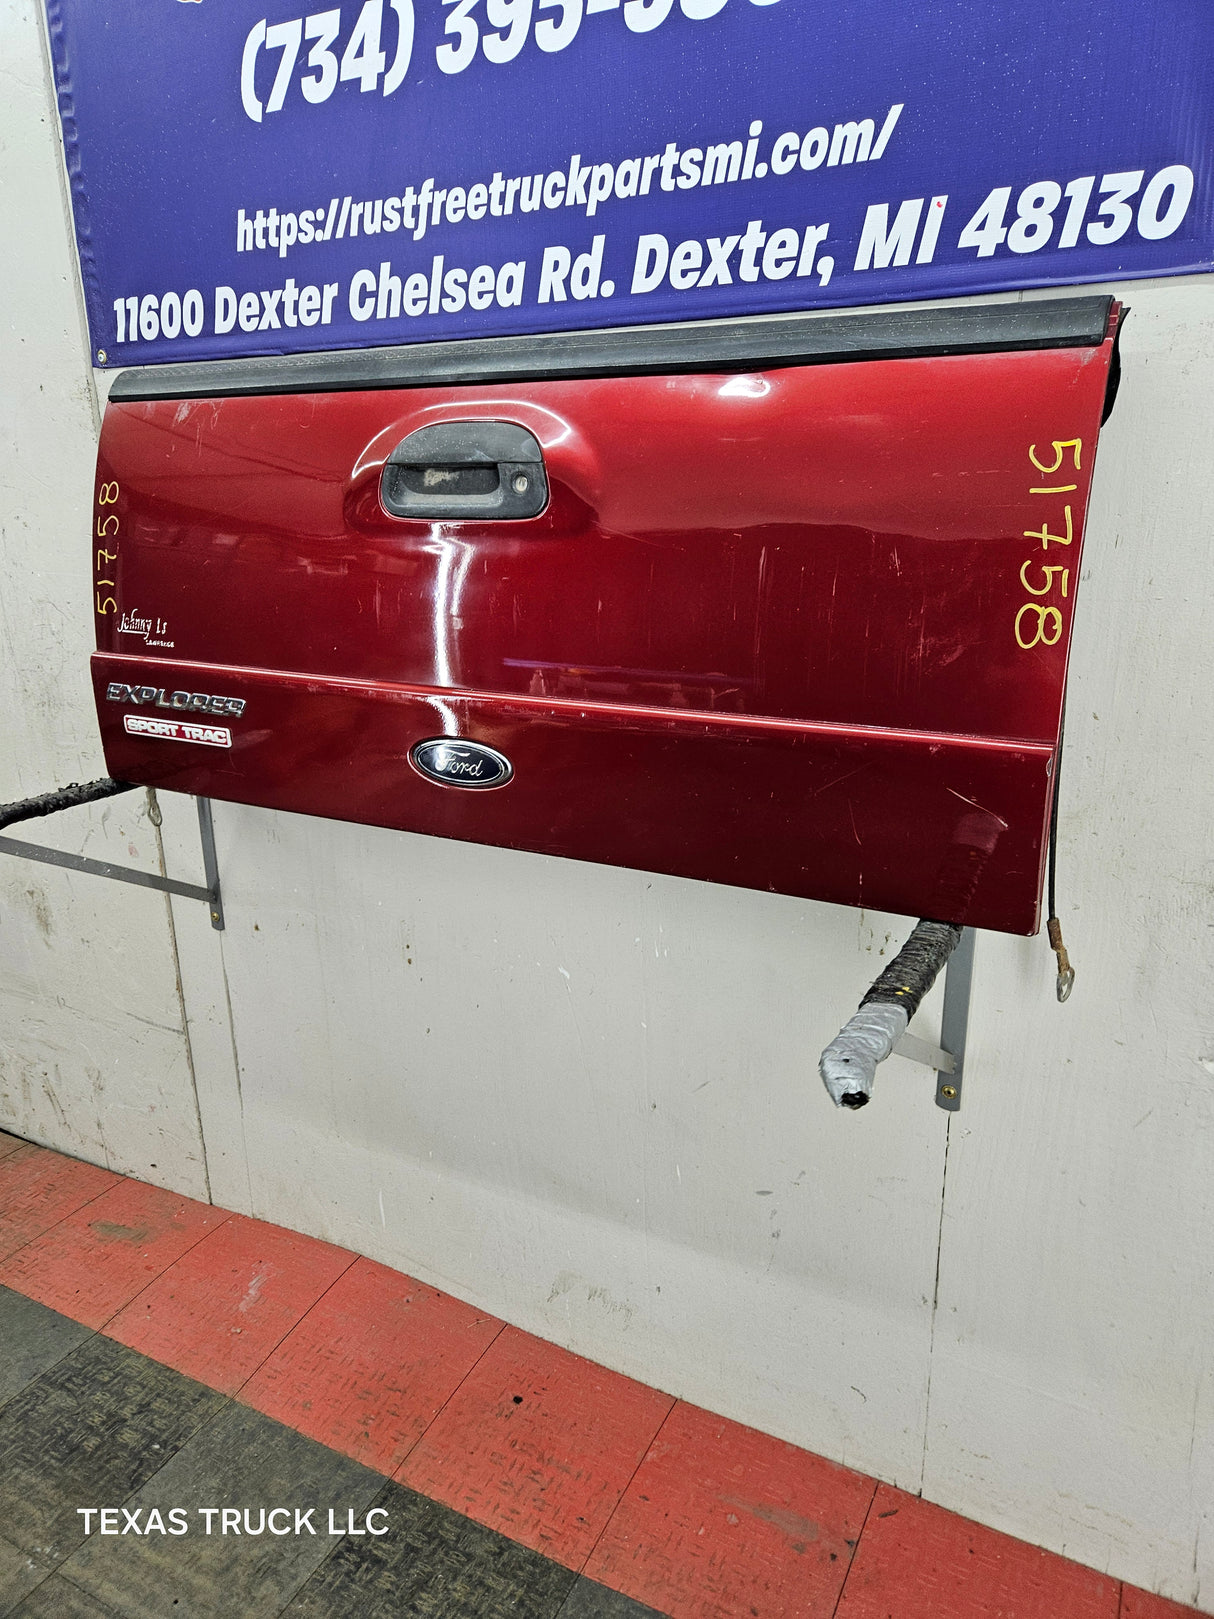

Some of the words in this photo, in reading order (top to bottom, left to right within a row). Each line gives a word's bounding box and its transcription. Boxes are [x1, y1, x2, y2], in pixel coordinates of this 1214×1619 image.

[241, 0, 414, 122] (734)
[237, 104, 904, 257] https://rustfreetruckpartsmi.com/
[114, 289, 202, 342] 11600
[215, 283, 338, 334] Dexter
[349, 255, 525, 321] Chelsea
[538, 235, 614, 303] Rd.
[631, 220, 834, 294] Dexter,
[854, 195, 948, 270] MI
[958, 165, 1193, 257] 48130
[97, 481, 120, 614] 51758
[1015, 438, 1082, 649] 51758
[106, 682, 246, 717] EXPLORER
[127, 718, 179, 737] SPORT
[182, 726, 227, 743] TRAC
[435, 748, 483, 777] Ford
